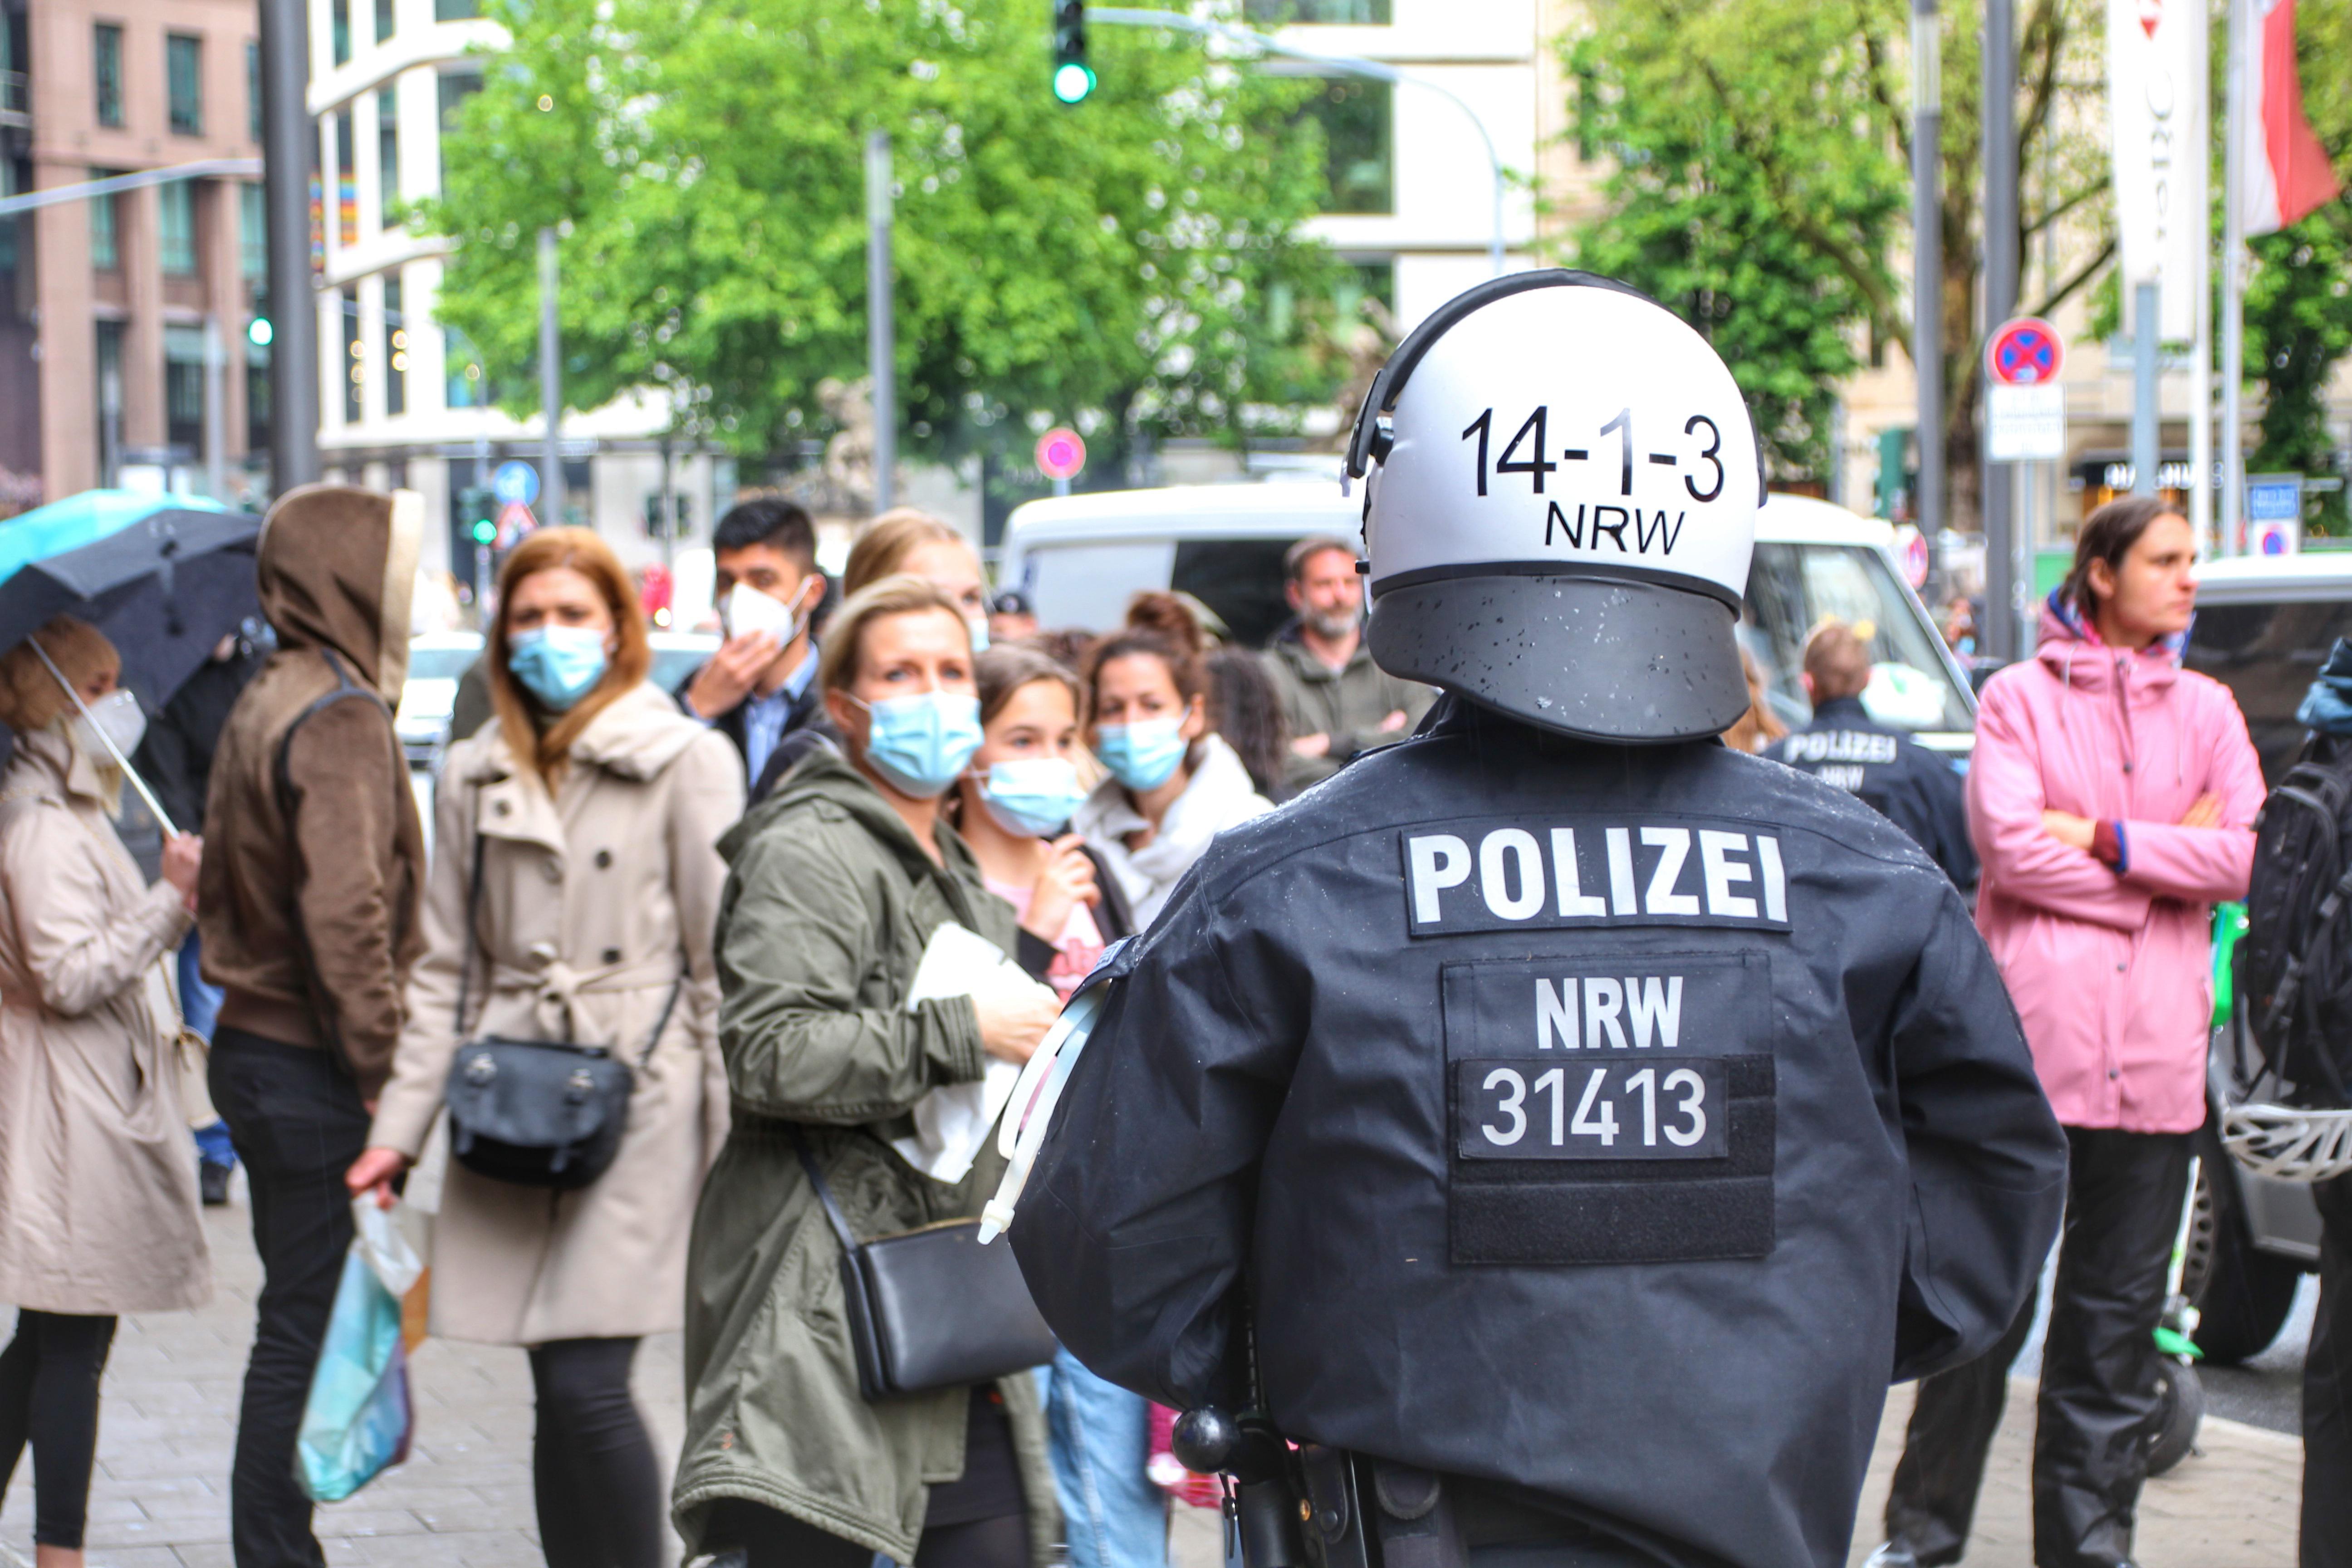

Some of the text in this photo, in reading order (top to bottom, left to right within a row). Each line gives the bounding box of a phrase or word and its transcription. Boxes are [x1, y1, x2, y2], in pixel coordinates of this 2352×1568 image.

[1461, 405, 1725, 503] 14-1-3
[1545, 500, 1685, 555] NRW
[1783, 730, 1896, 764] POLIZEI
[1409, 827, 1788, 923] POLIZEI
[1536, 976, 1683, 1049] NRW
[1482, 1068, 1706, 1147] 31413
